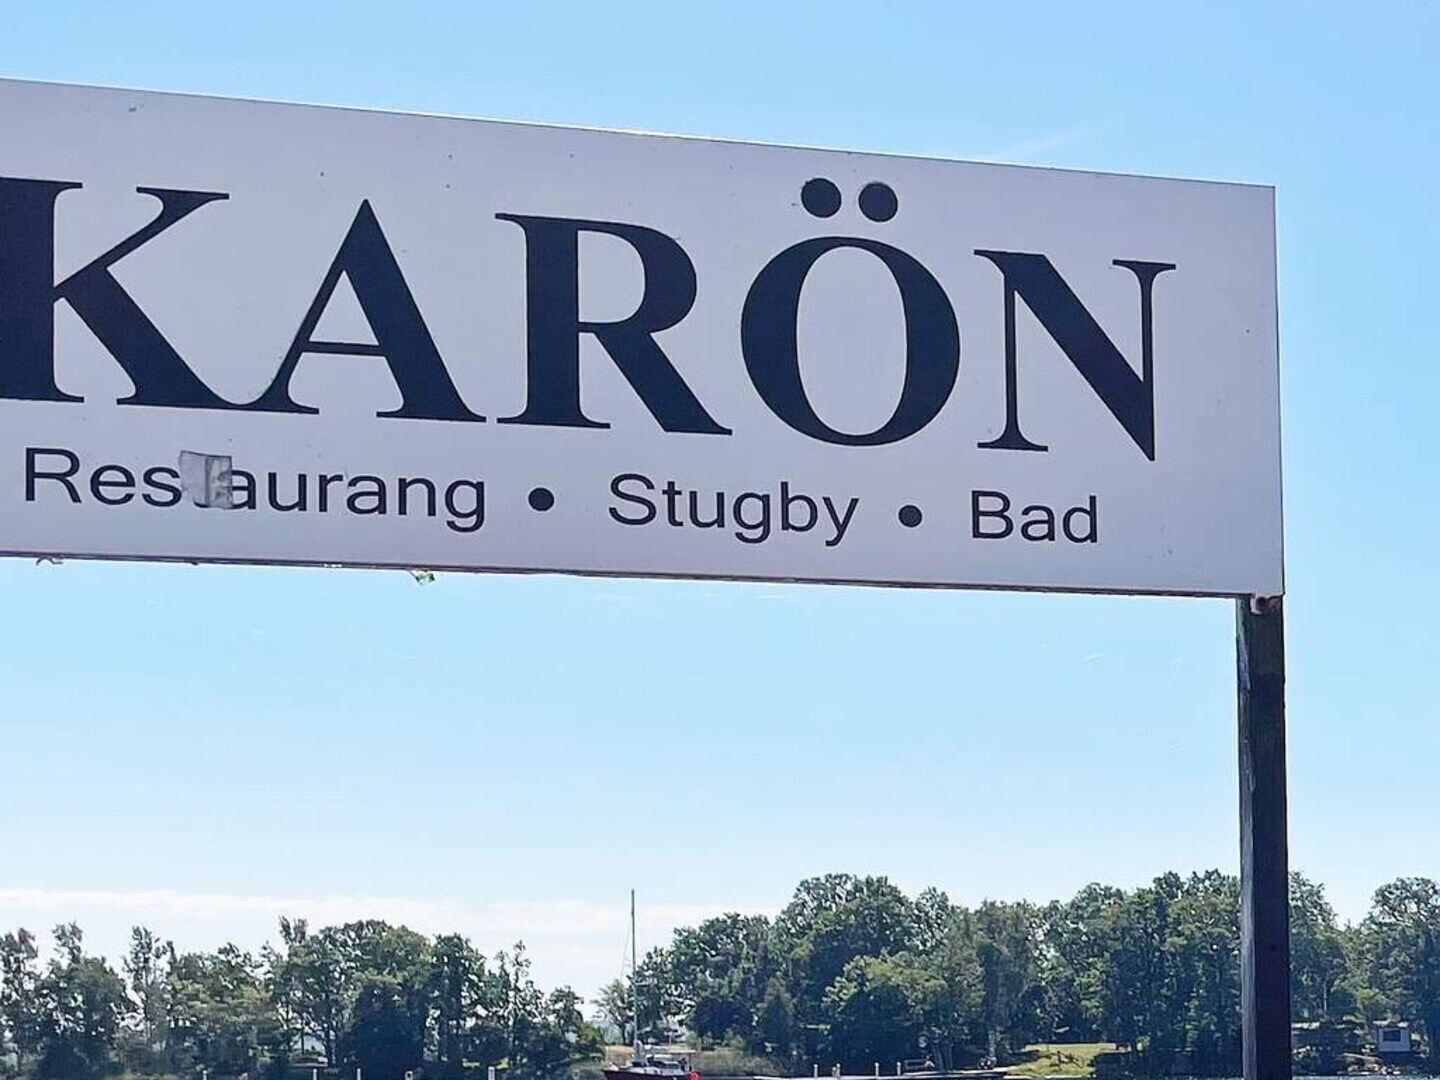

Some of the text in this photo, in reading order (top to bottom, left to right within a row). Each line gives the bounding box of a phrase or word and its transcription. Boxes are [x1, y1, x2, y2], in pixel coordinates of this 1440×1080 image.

[0, 176, 1177, 462] KARÖN
[25, 447, 1098, 547] Resaurang Stugby Bad
